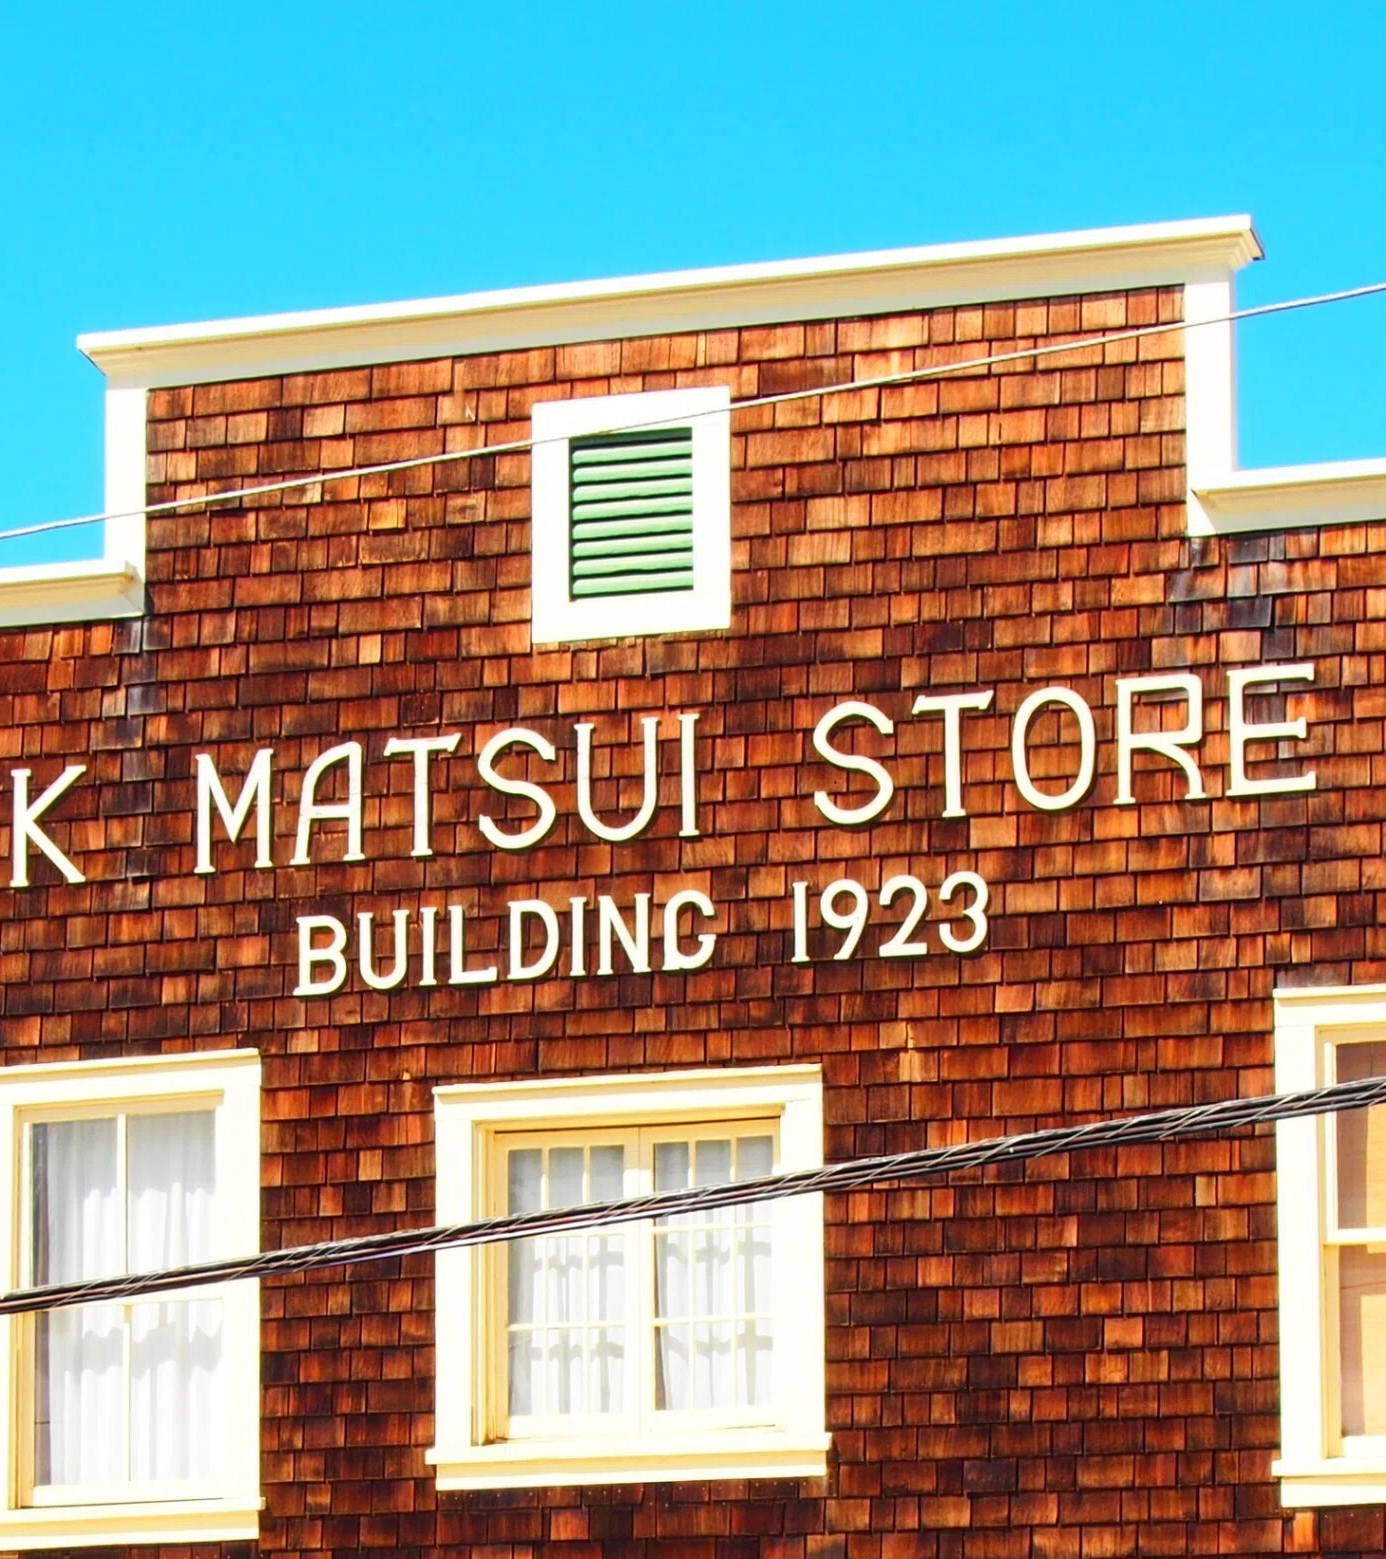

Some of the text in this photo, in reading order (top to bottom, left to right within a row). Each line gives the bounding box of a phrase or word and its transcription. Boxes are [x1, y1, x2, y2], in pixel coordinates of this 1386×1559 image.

[11, 663, 1316, 888] K MATSUI STORE
[293, 871, 990, 997] BUILDING 1923
